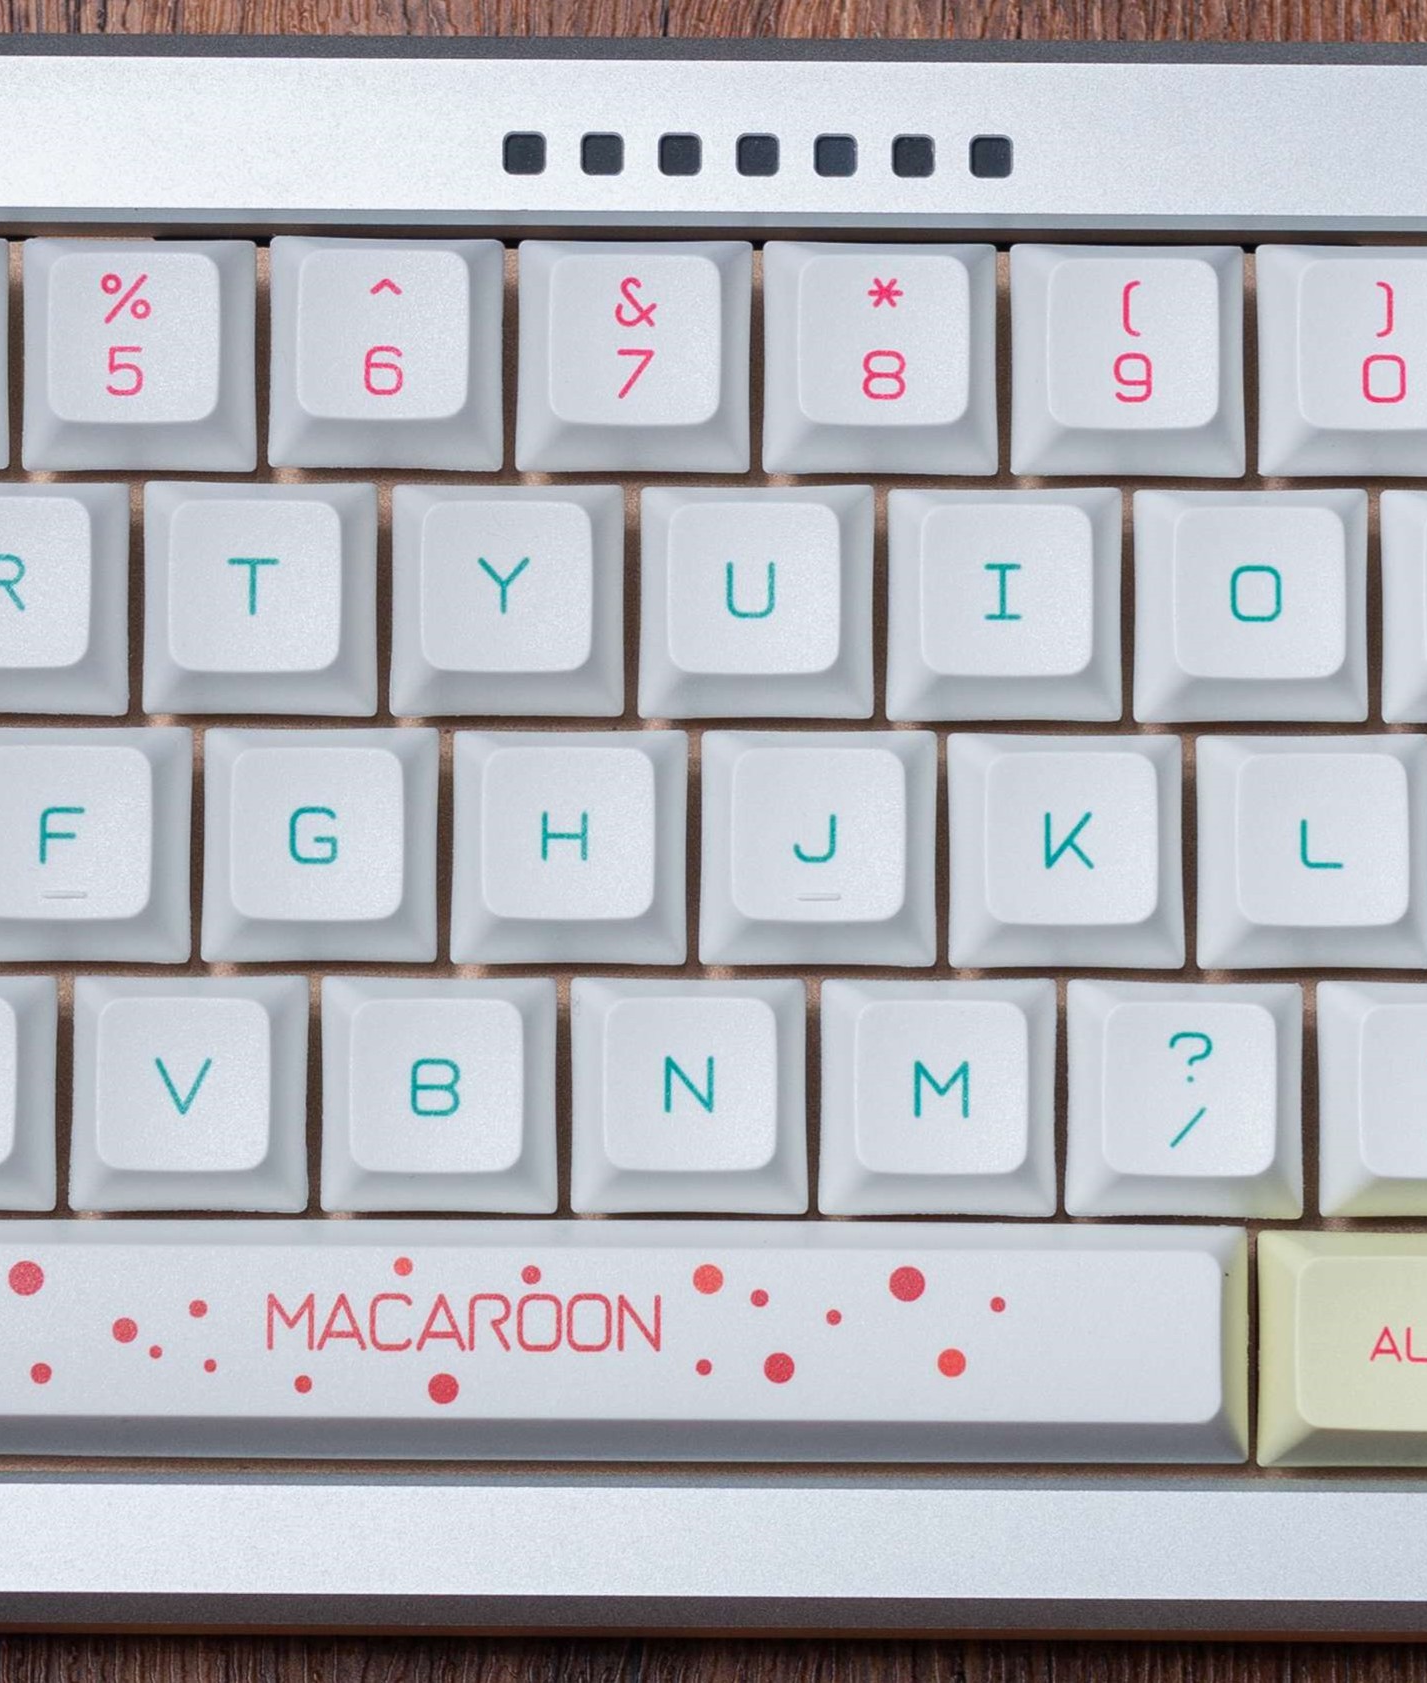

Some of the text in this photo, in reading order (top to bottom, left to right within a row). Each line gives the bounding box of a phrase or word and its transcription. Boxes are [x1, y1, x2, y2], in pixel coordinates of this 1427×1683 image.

[100, 273, 152, 325] %
[369, 277, 403, 296] ^
[614, 276, 658, 328] &
[1122, 280, 1141, 338] (
[1376, 281, 1394, 338] )
[105, 345, 144, 397] 5
[363, 345, 404, 396] 6
[616, 348, 655, 400] 7
[862, 349, 907, 401] 8
[1113, 352, 1153, 403] 9
[1362, 354, 1407, 404] 0
[227, 557, 280, 616] T
[477, 556, 530, 615] Y
[725, 561, 776, 620] U
[984, 562, 1022, 622] I
[1229, 564, 1283, 623] O
[38, 806, 86, 865] F
[288, 806, 338, 865] G
[540, 811, 589, 862] H
[793, 813, 838, 864] J
[1043, 811, 1094, 870] K
[1299, 819, 1344, 870] L
[663, 1055, 715, 1113] N
[1168, 1031, 1214, 1083] ?
[154, 1057, 213, 1116] V
[410, 1057, 461, 1118] B
[913, 1060, 970, 1119] M
[1169, 1106, 1207, 1149] /
[266, 1292, 662, 1353] MACAROON
